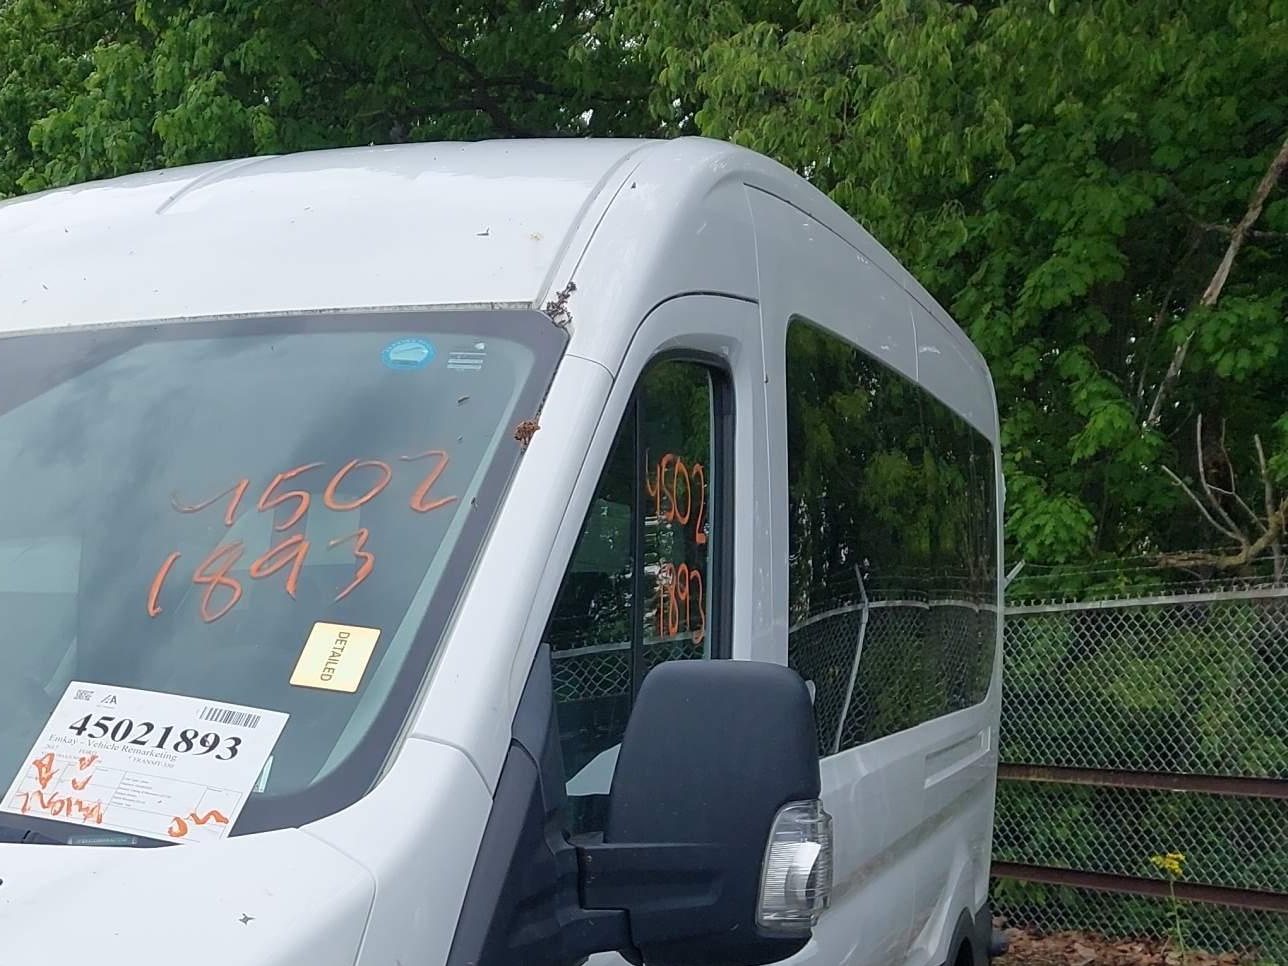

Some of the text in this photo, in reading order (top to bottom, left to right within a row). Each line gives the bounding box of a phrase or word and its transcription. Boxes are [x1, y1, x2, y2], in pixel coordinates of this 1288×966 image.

[147, 527, 376, 624] 1893
[320, 631, 350, 682] DETAILED
[49, 734, 78, 745] Emkay
[87, 740, 119, 752] Vehicle
[121, 745, 178, 762] Remarketing
[68, 713, 243, 761] 45021893
